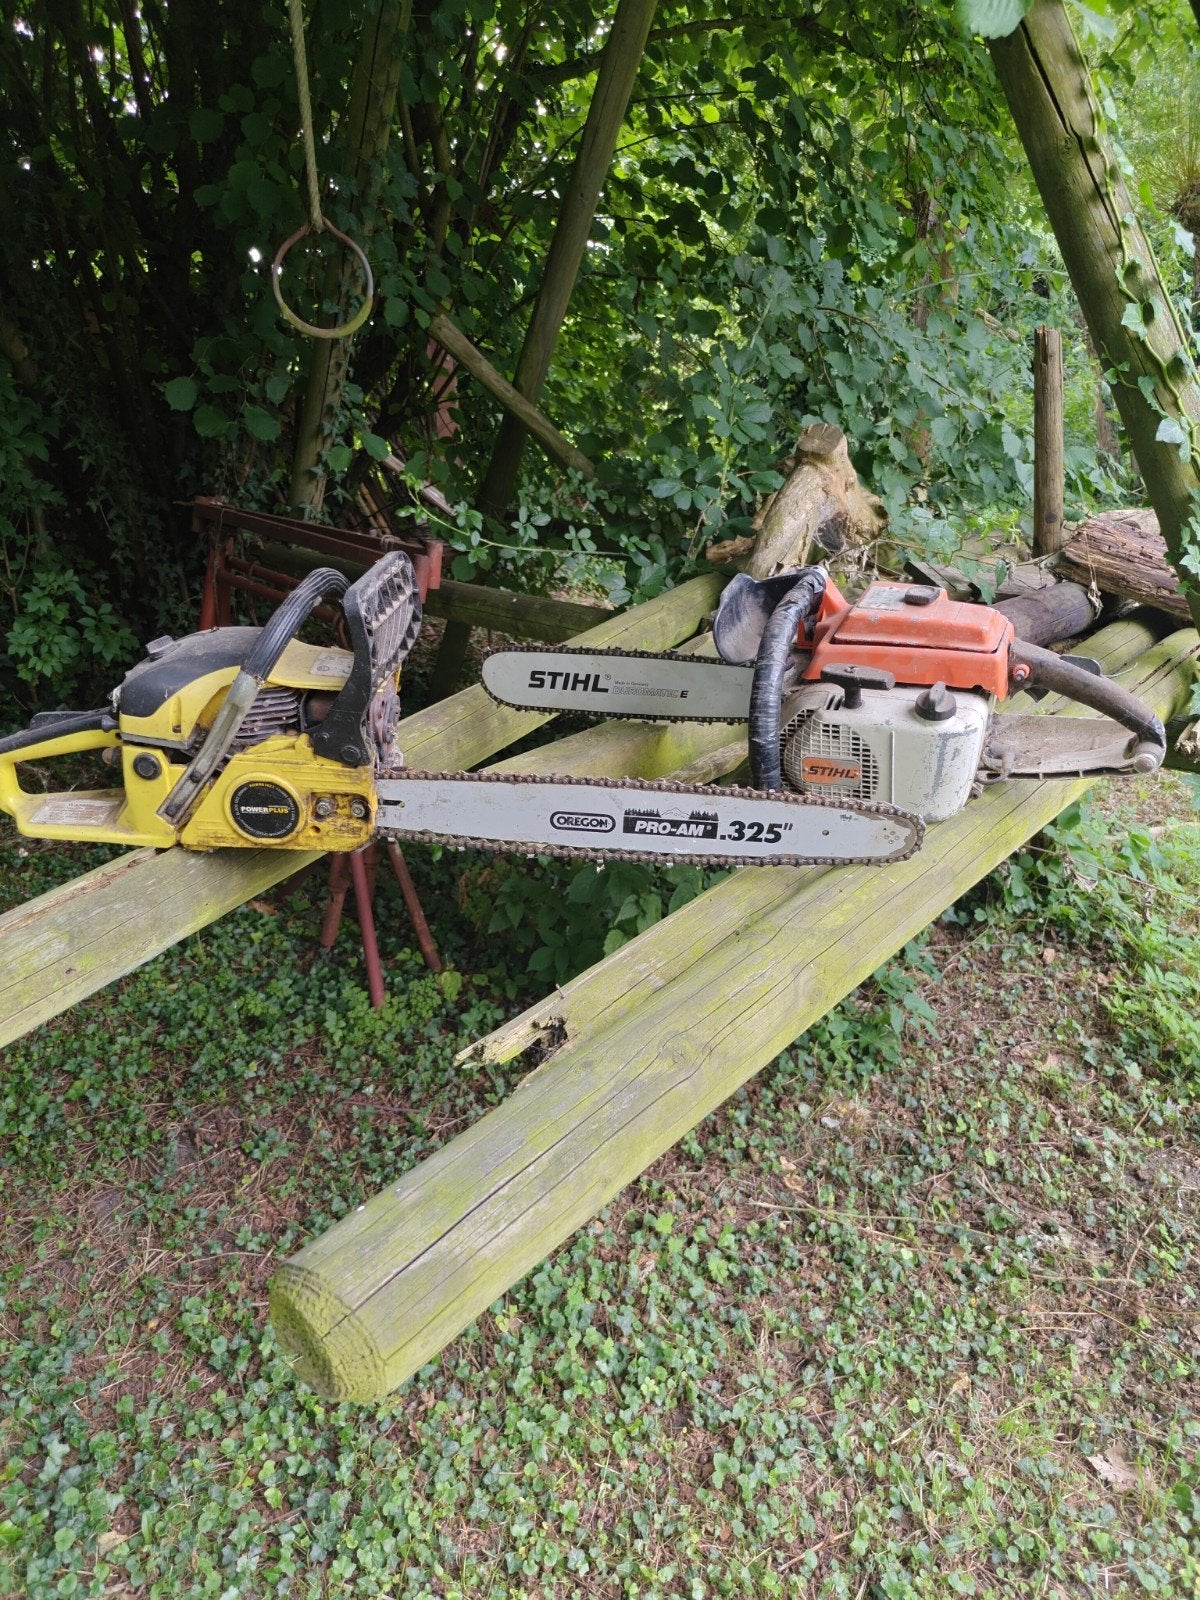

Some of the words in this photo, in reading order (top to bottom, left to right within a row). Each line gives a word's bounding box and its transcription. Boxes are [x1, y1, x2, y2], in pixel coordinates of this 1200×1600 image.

[528, 670, 609, 693] STIHL
[808, 765, 855, 779] STIHL
[241, 806, 289, 814] POWERPLUS
[556, 815, 609, 829] OREGON
[634, 820, 705, 837] PRO-AM
[719, 820, 793, 844] .325"
